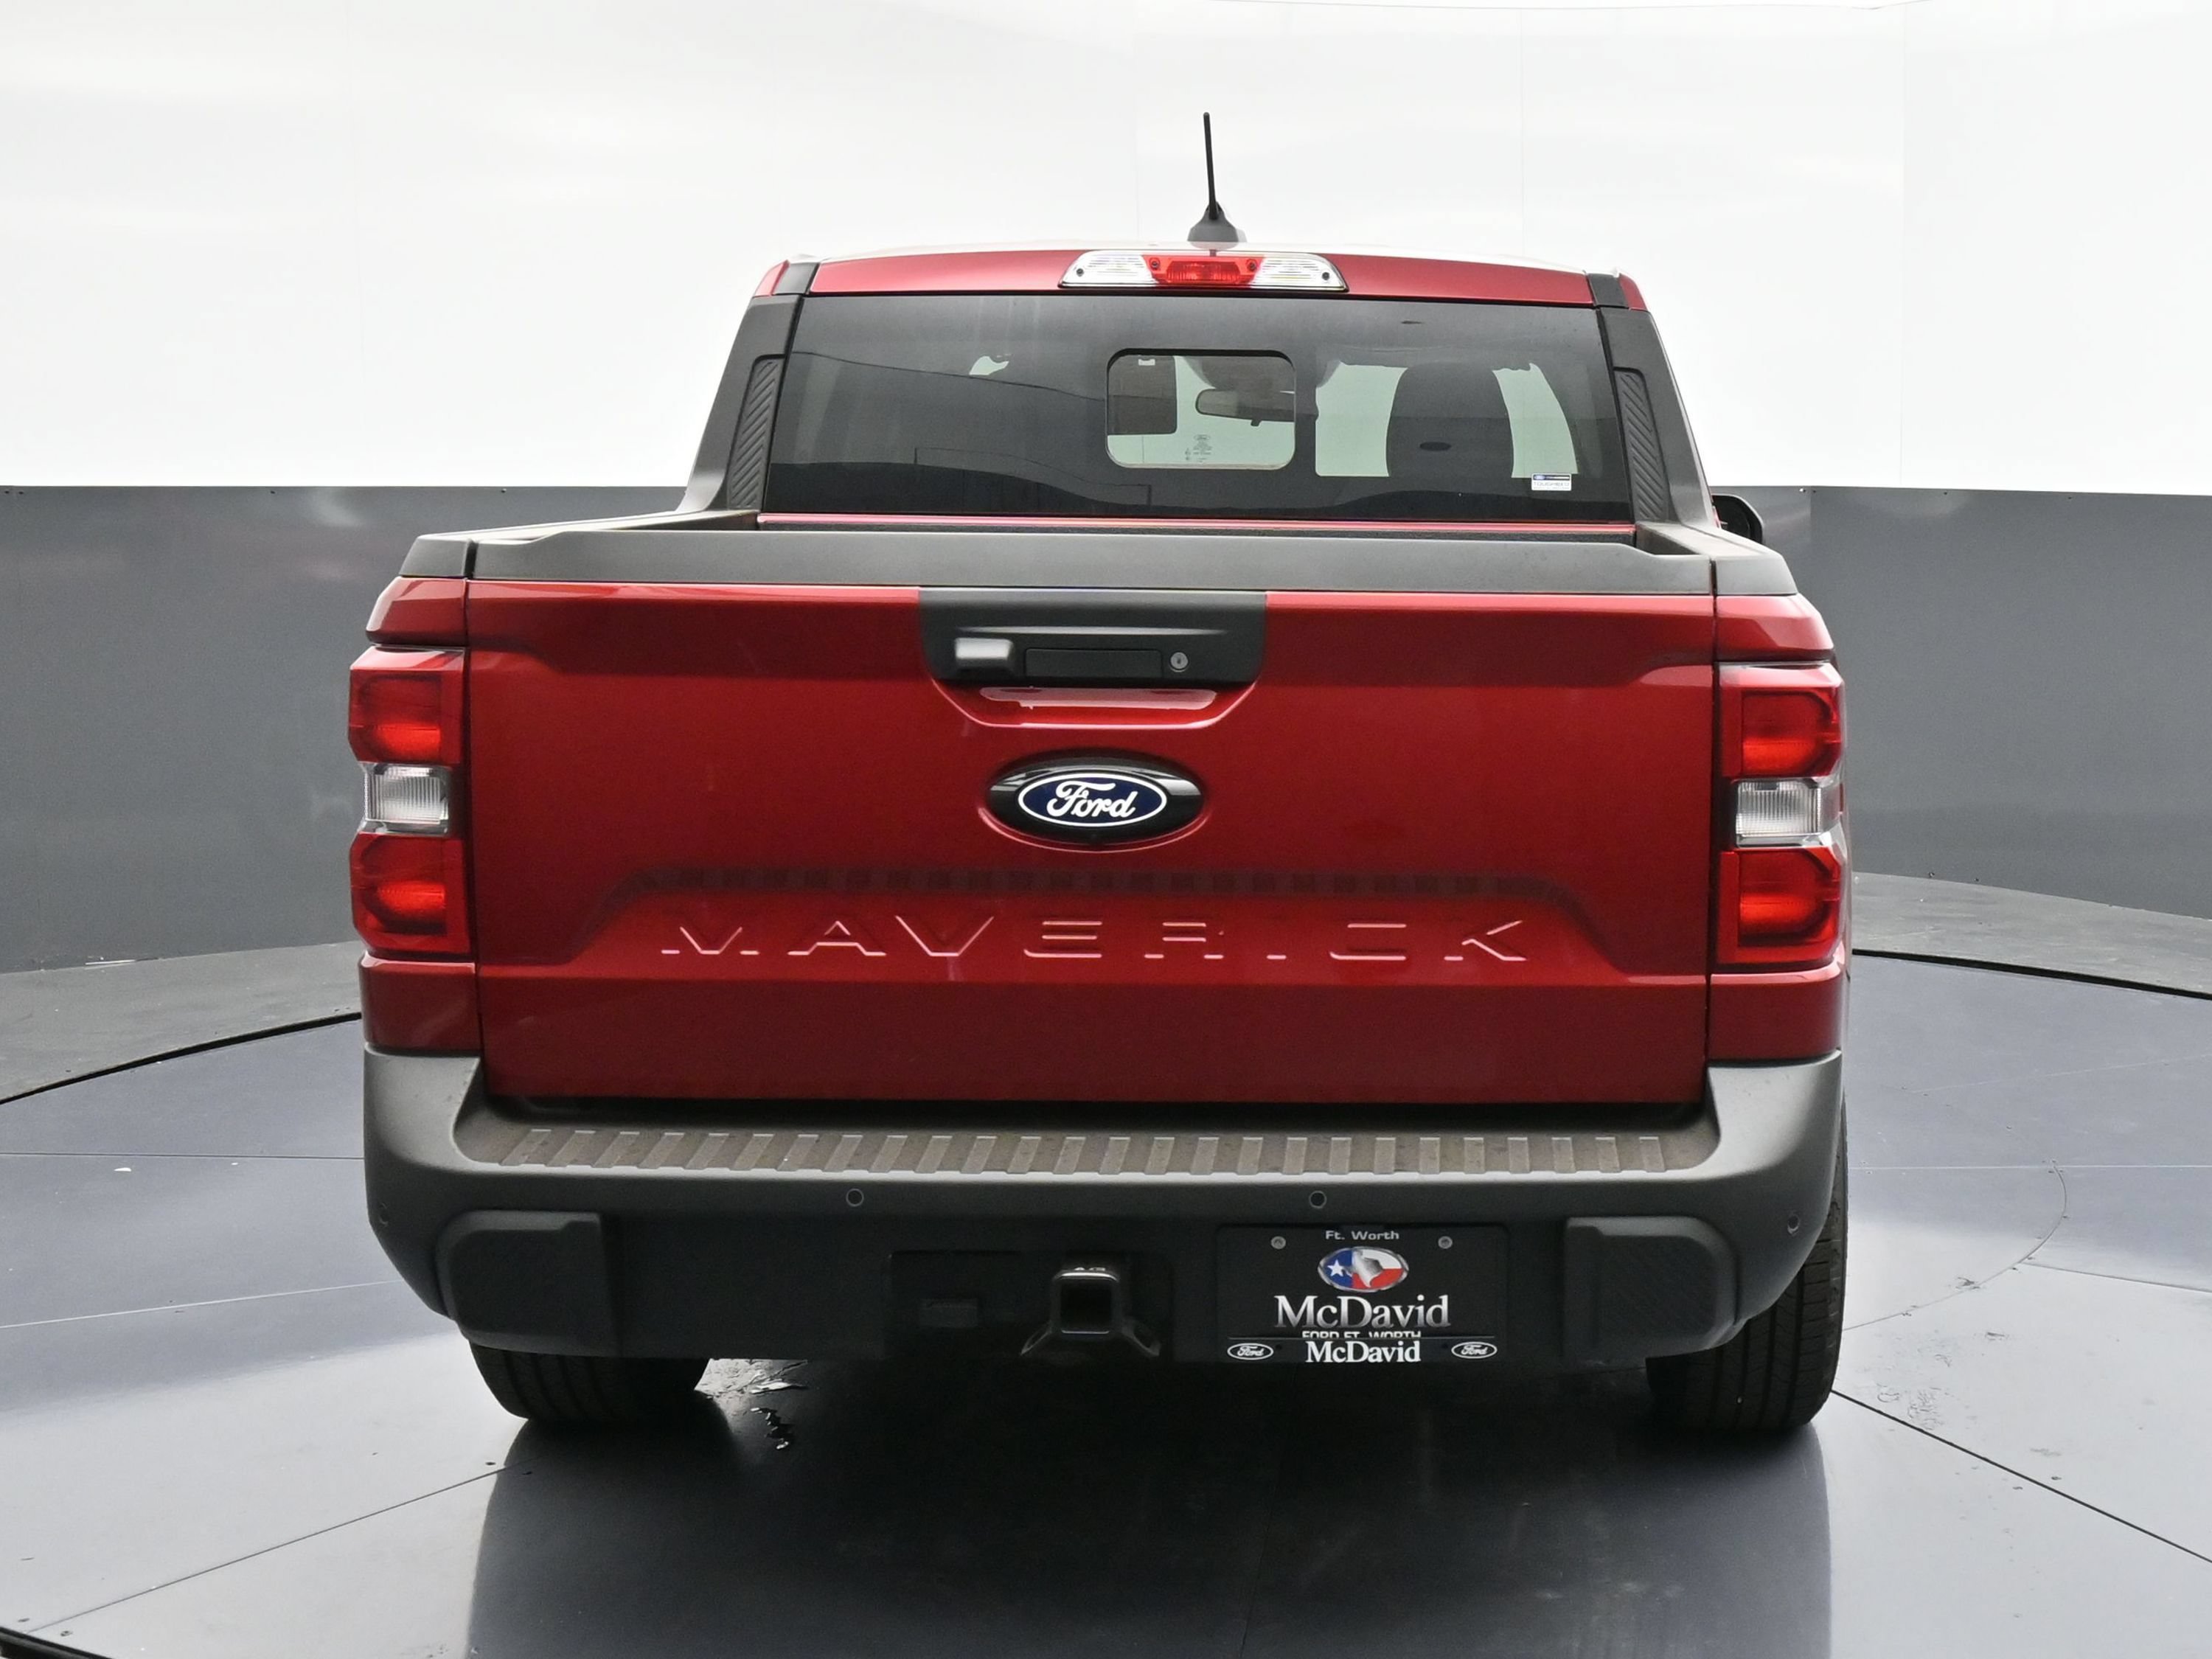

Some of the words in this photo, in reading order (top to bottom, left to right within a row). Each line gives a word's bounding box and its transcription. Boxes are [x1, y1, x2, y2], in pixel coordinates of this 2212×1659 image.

[1046, 780, 1138, 818] Ford
[661, 915, 1528, 961] MAVERICK
[1325, 1230, 1346, 1240] Ft.
[1351, 1230, 1399, 1240] Worth
[1273, 1294, 1451, 1328] McDavid
[1237, 1346, 1265, 1356] Ford
[1305, 1340, 1422, 1363] McDavid
[1461, 1345, 1488, 1355] Ford
